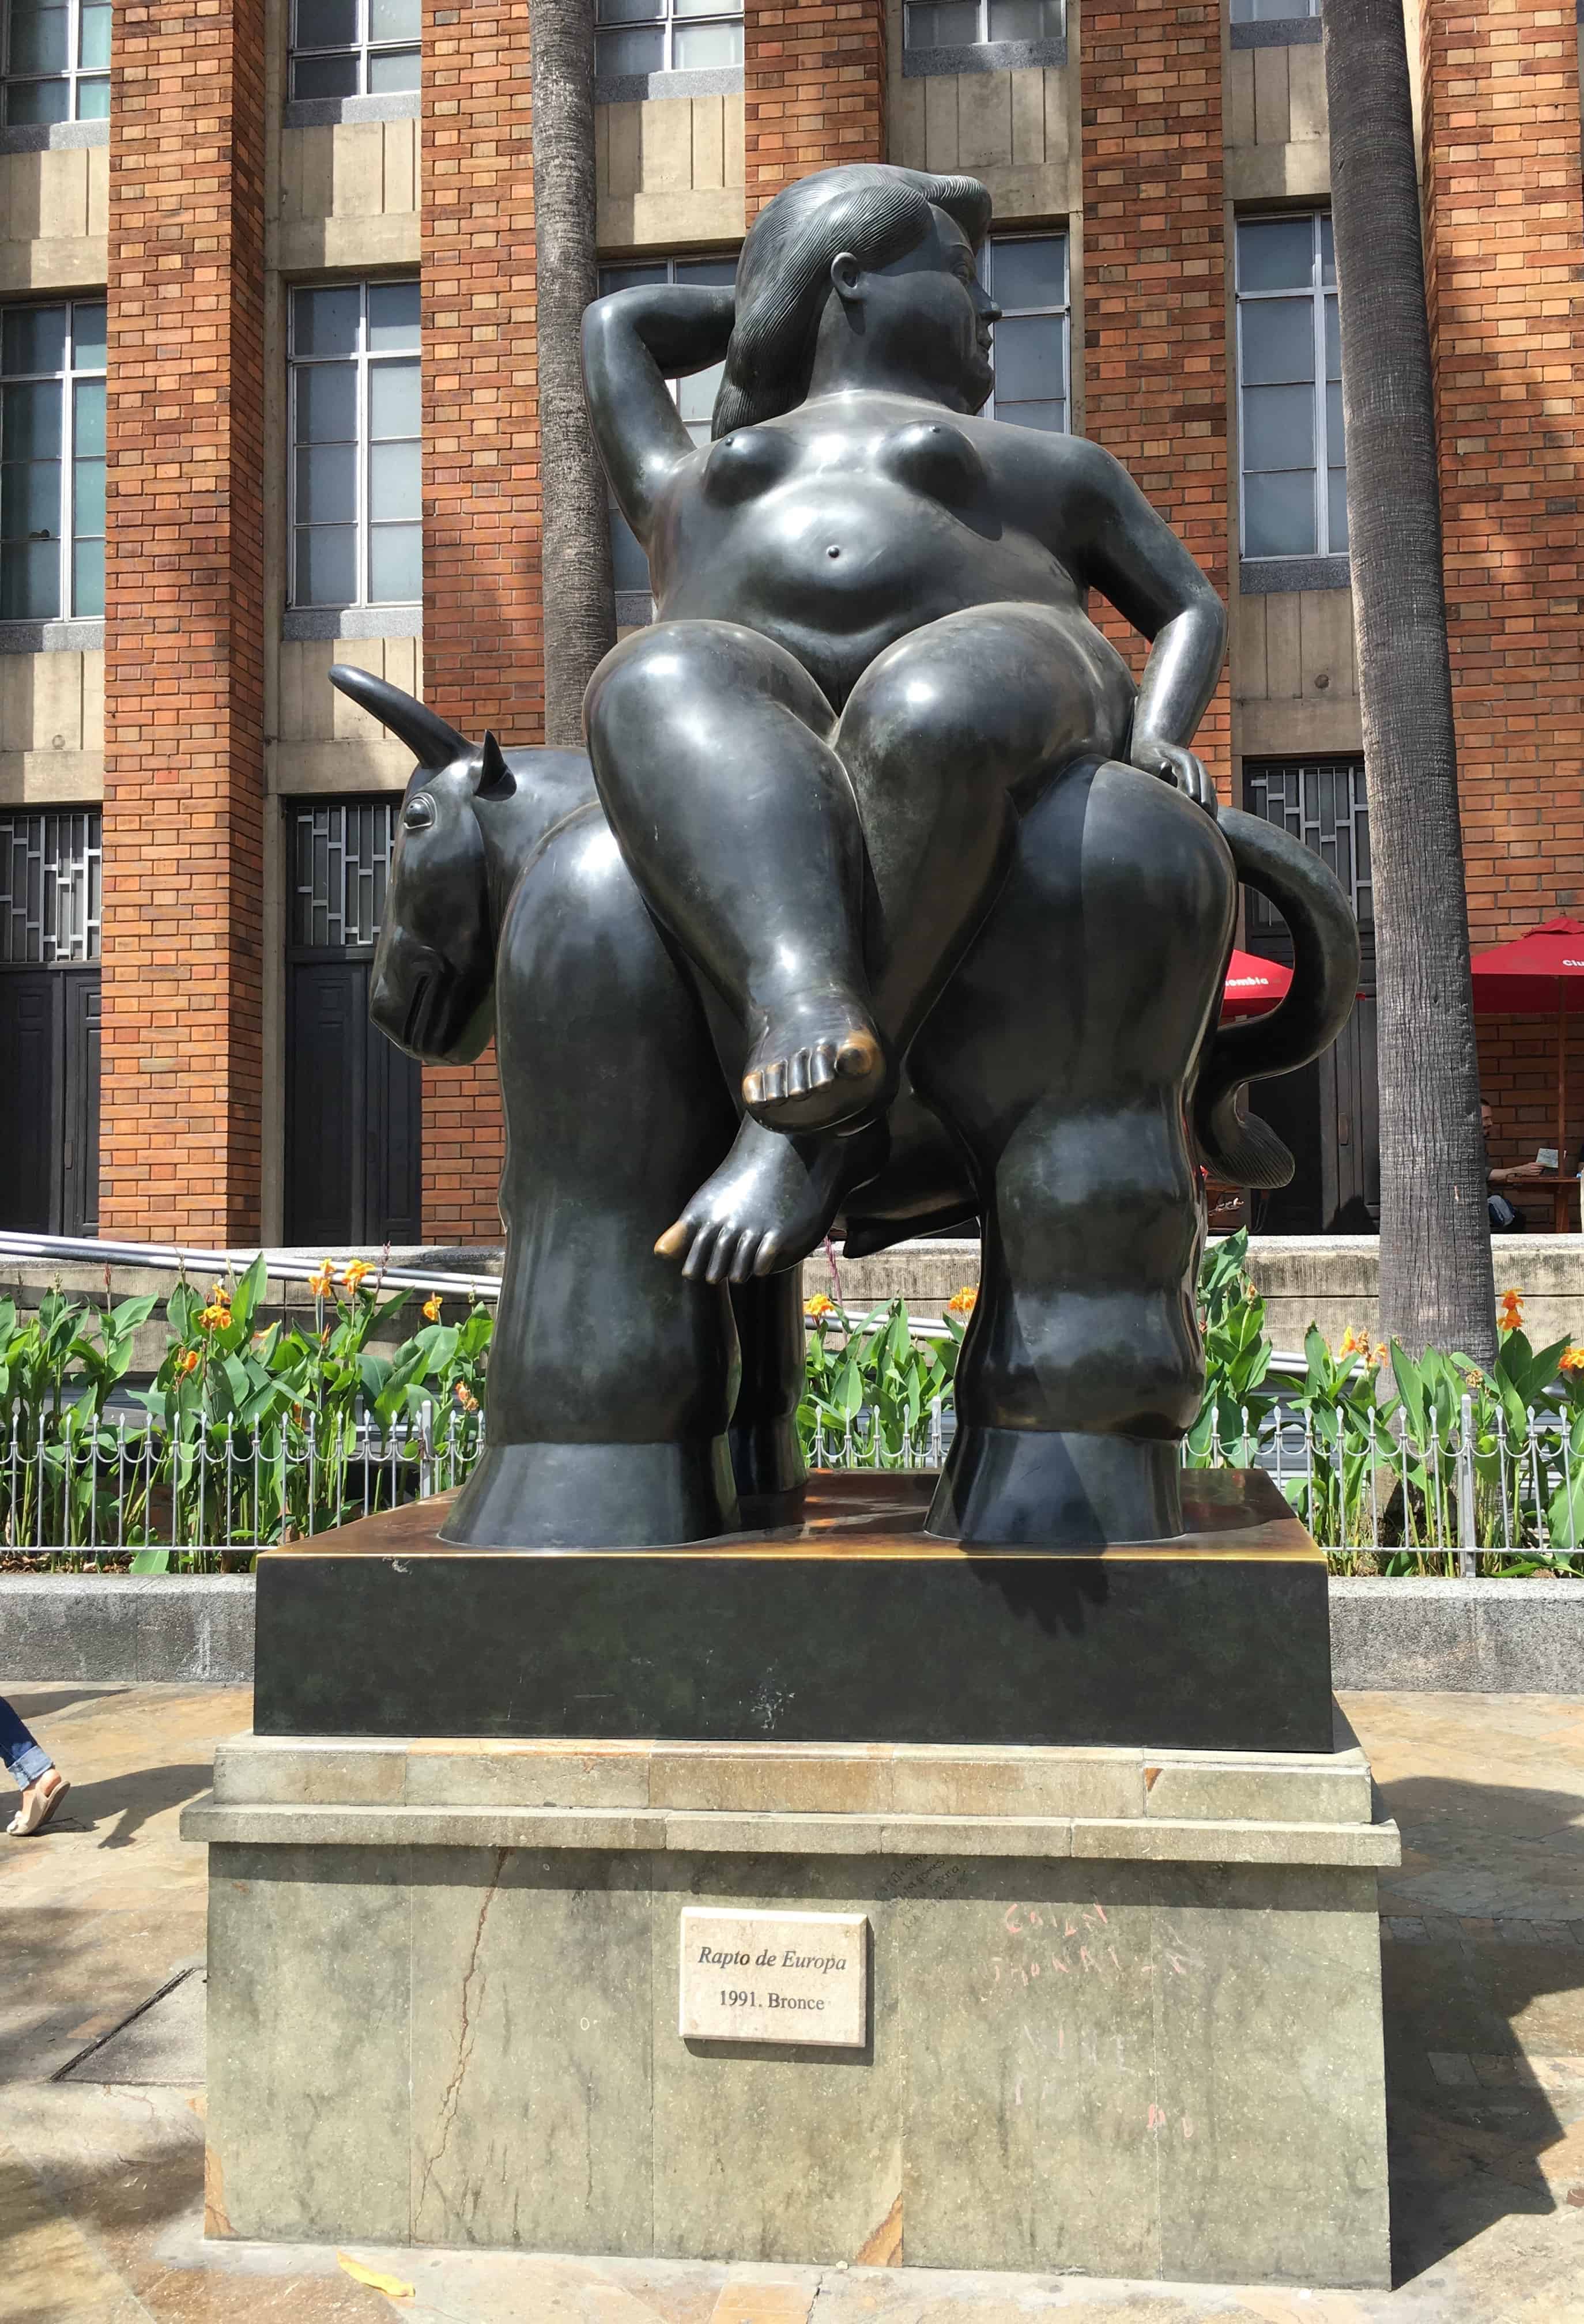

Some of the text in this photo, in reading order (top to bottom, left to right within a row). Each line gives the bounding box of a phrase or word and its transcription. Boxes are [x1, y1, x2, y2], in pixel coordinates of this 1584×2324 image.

[697, 1946, 847, 1974] Rapto de Europa
[720, 1990, 825, 2010] 1991. Bronce
